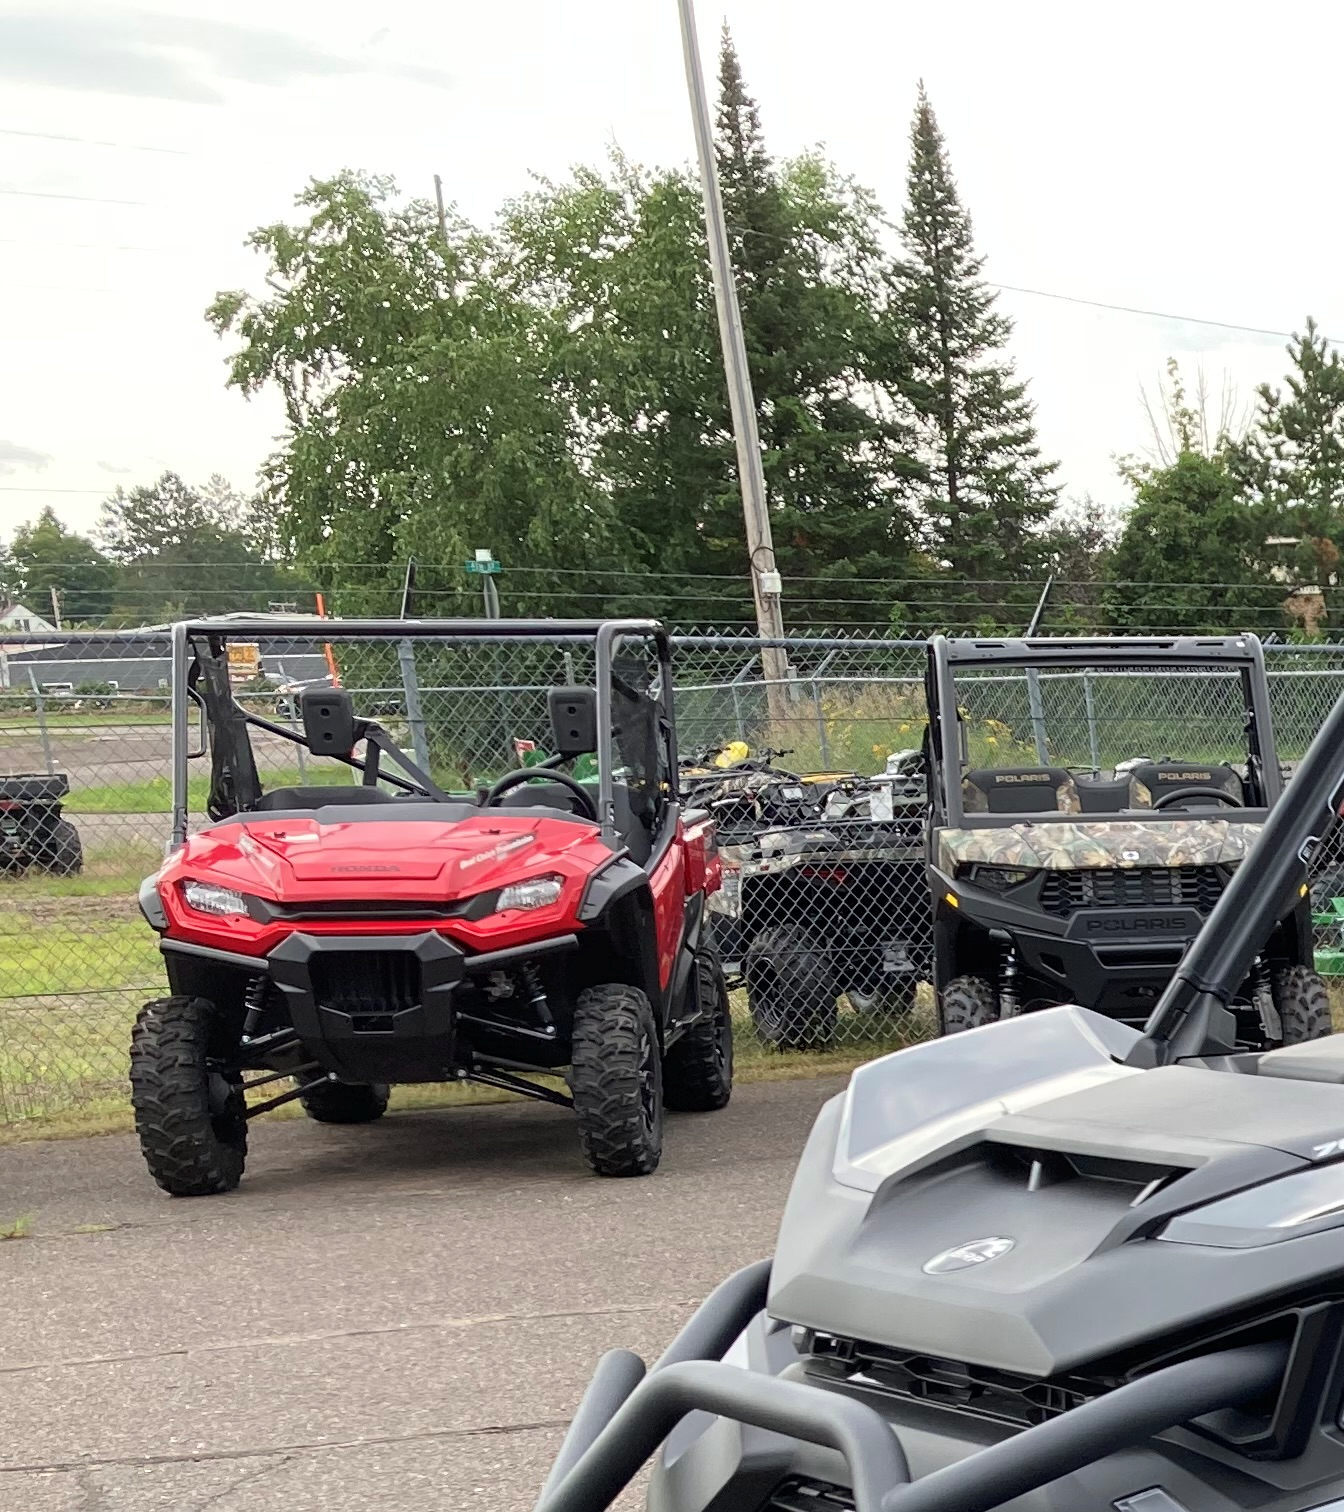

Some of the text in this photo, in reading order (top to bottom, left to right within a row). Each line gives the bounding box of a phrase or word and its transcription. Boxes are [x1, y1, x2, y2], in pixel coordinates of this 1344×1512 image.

[995, 773, 1050, 783] POLARIS
[1158, 772, 1211, 781] POLARIS
[1087, 918, 1186, 931] POLARIS
